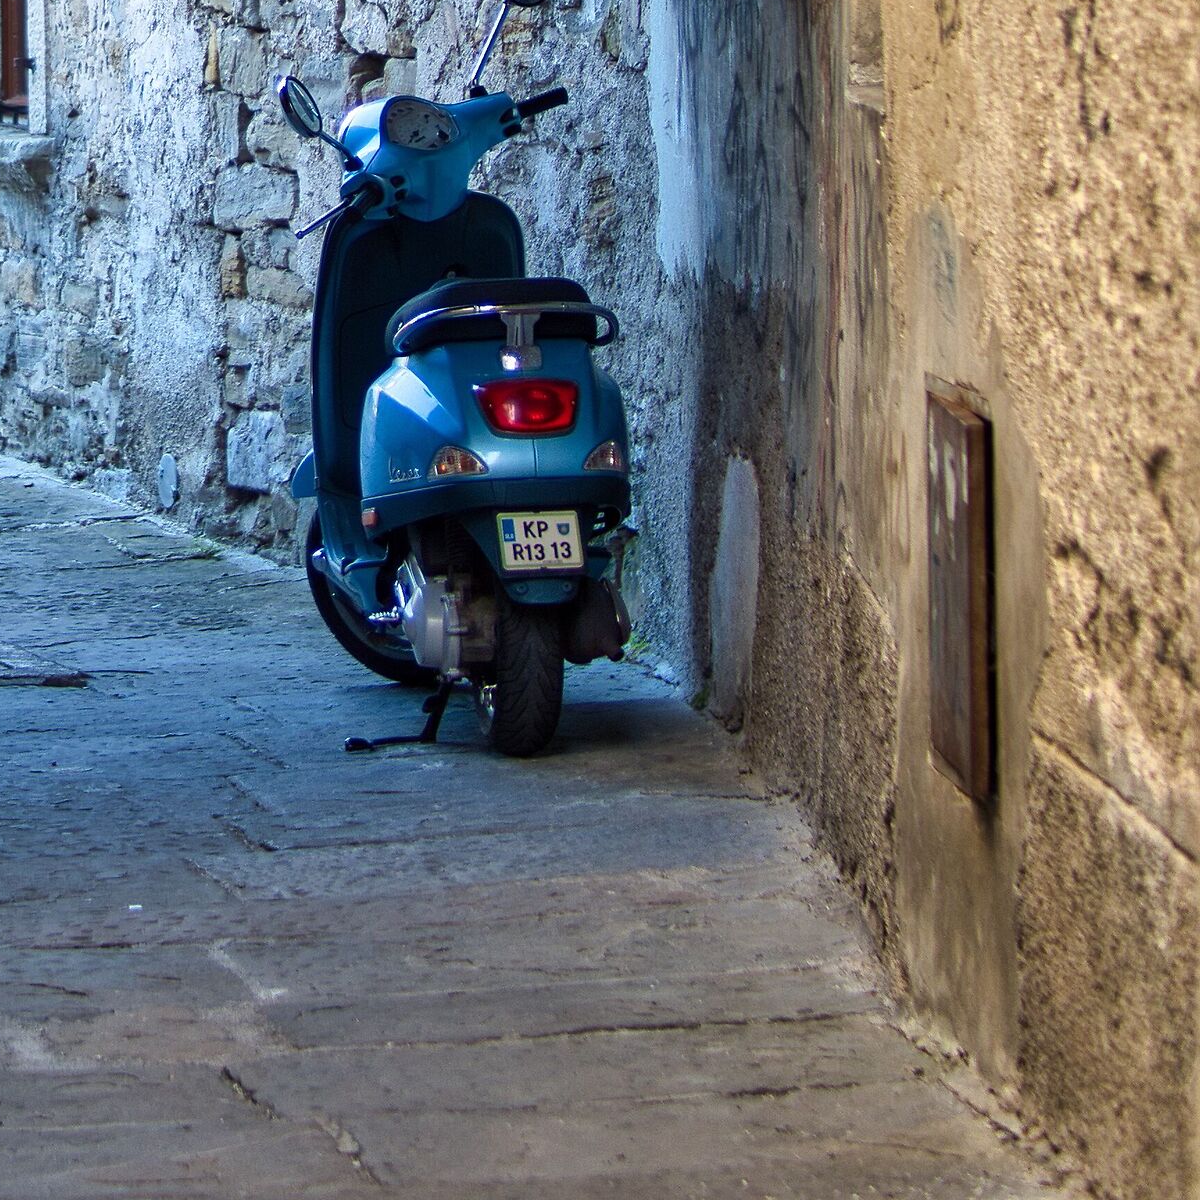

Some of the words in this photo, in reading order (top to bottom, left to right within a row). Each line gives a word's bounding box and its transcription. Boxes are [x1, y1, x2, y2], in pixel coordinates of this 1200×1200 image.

[523, 521, 548, 538] KP
[512, 543, 545, 561] R13
[550, 541, 572, 559] 13
